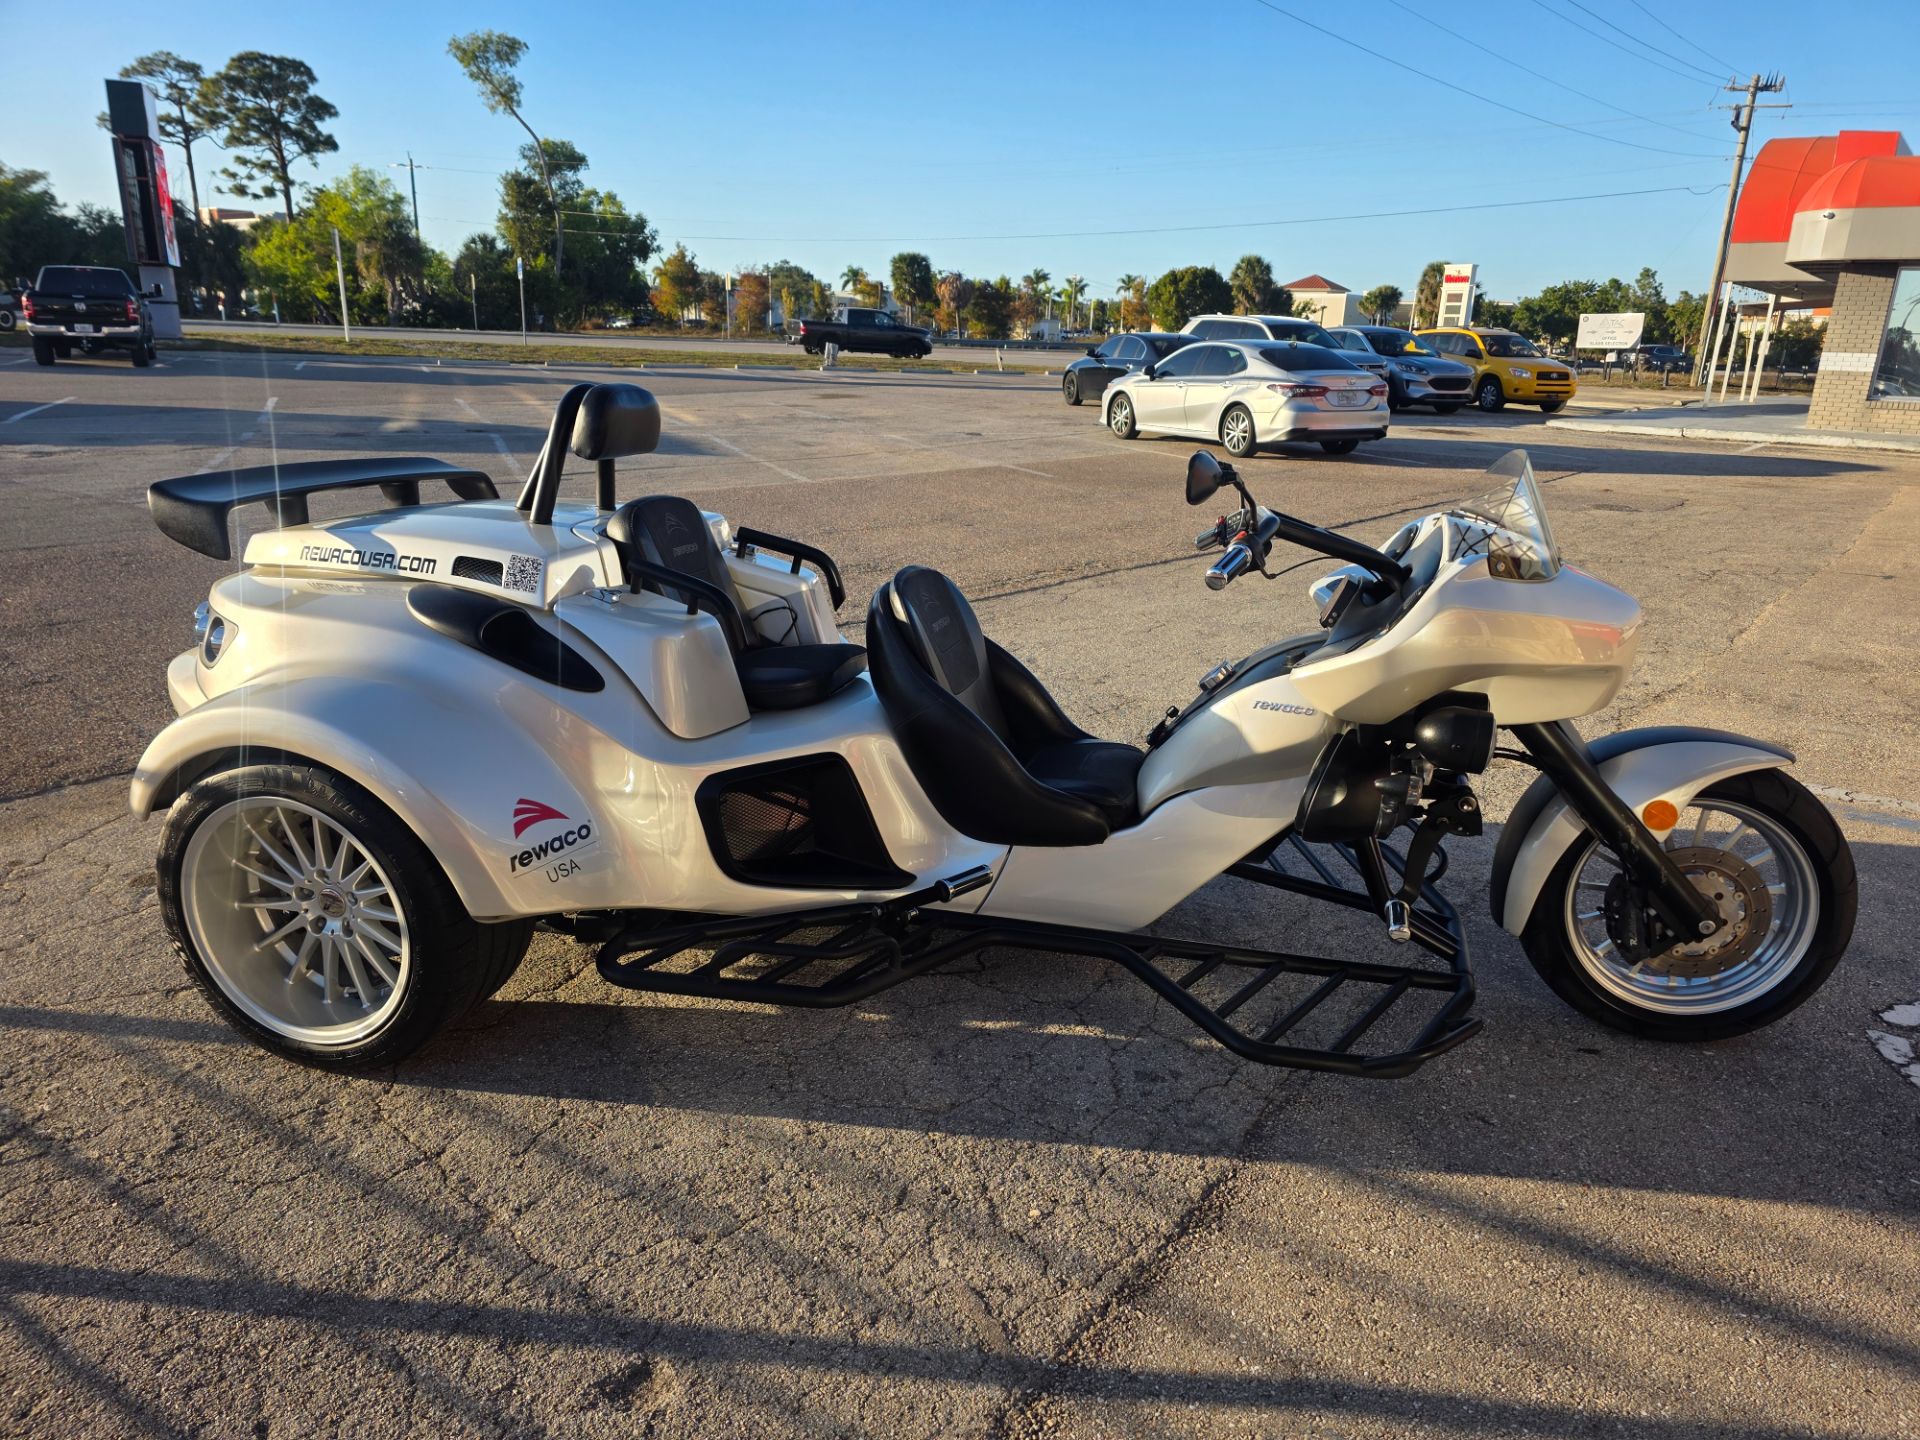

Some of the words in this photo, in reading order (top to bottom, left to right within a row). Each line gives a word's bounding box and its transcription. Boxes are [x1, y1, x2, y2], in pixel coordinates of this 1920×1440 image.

[300, 545, 437, 574] REWACOUSA.COM
[1252, 700, 1314, 716] rewaco
[545, 858, 581, 883] USA
